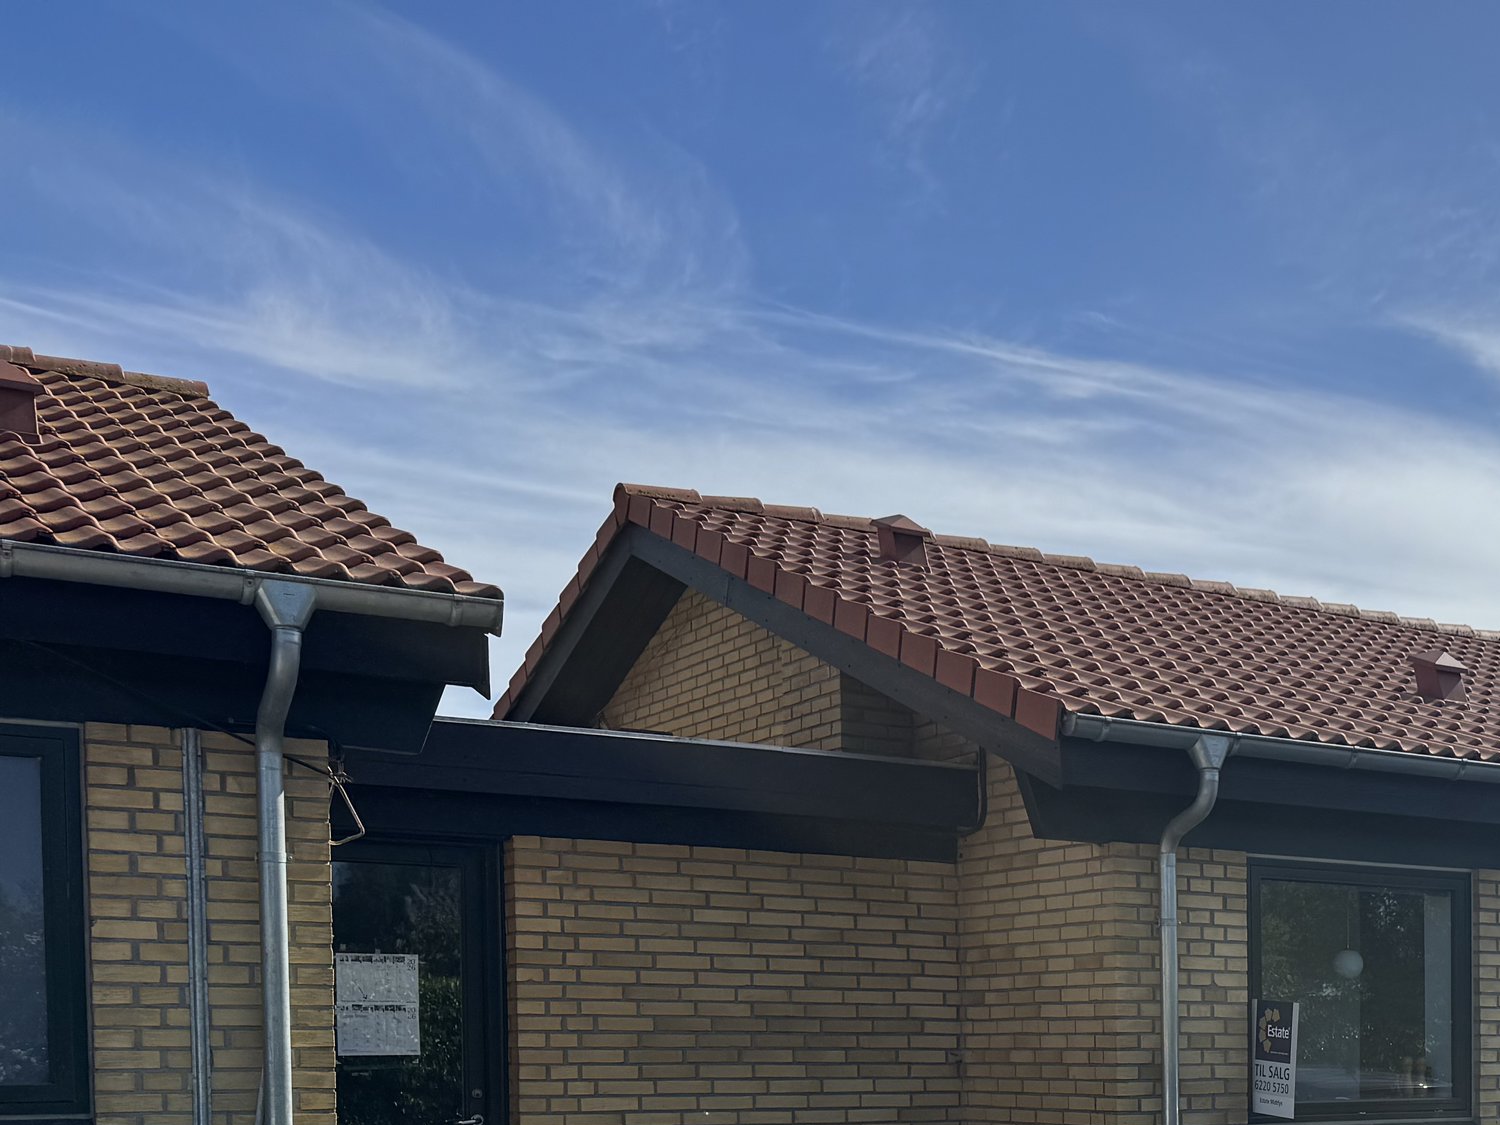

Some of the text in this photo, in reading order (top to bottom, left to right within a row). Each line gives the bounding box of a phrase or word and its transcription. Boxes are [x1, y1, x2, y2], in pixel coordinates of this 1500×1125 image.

[1267, 1024, 1290, 1039] Estate
[1255, 1064, 1290, 1081] TIL SALG
[1255, 1080, 1289, 1095] 6220 5750
